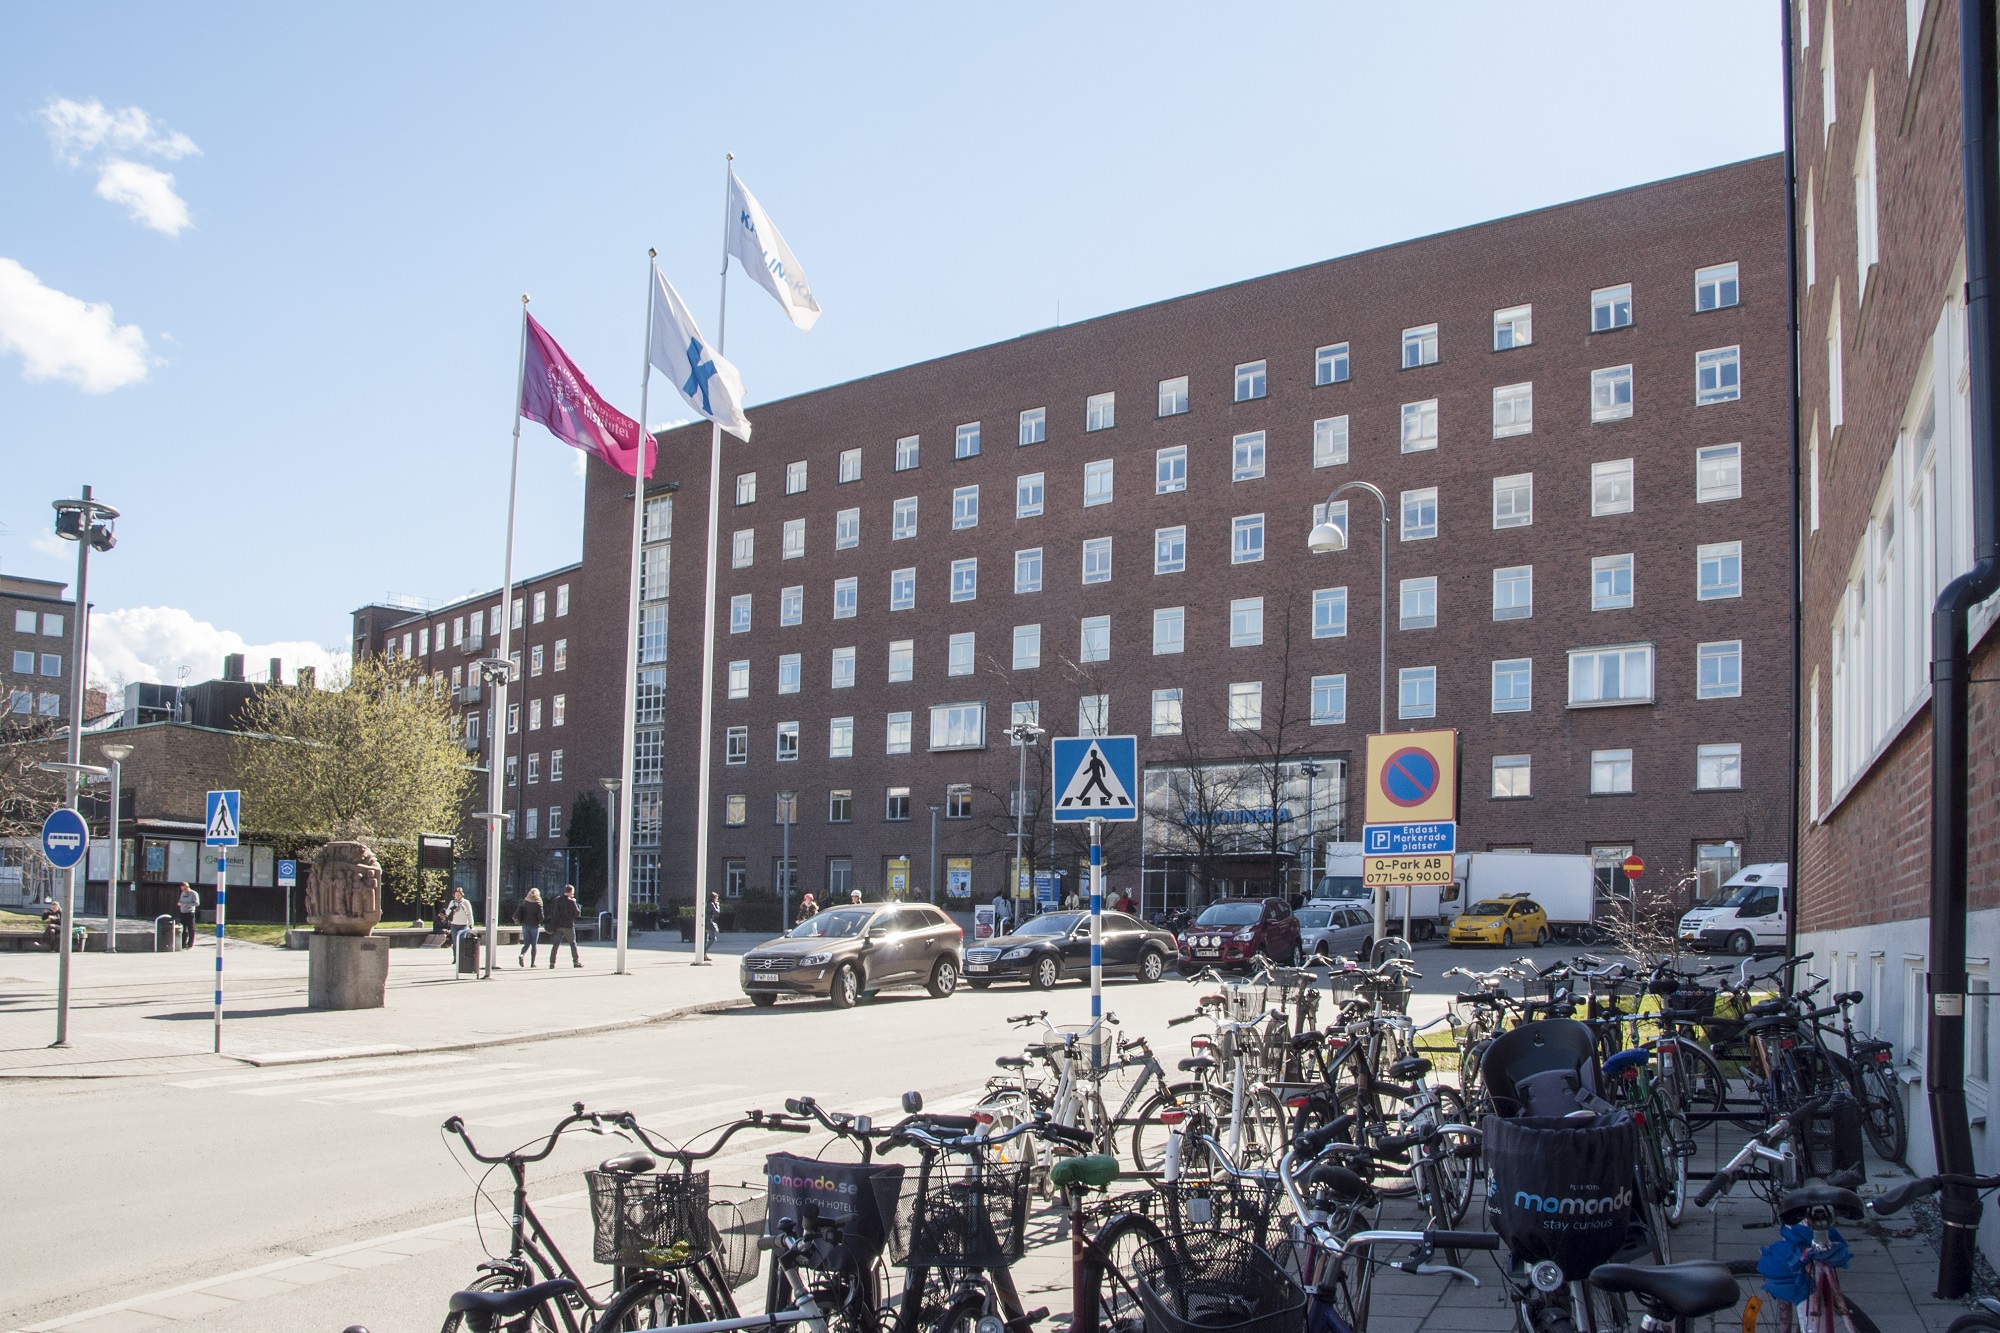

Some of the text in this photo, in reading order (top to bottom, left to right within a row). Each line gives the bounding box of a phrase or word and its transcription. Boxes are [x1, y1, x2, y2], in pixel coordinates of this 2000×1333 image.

[1403, 825, 1438, 834] Endast
[1377, 833, 1386, 847] P
[1393, 833, 1446, 843] Markerade
[1402, 842, 1437, 852] platser
[1375, 858, 1442, 870] Q-Park AB
[1366, 872, 1414, 883] 0771-96
[827, 1200, 858, 1213] HOTELL
[1514, 1186, 1632, 1215] momondo
[1543, 1219, 1613, 1232] stay curious
